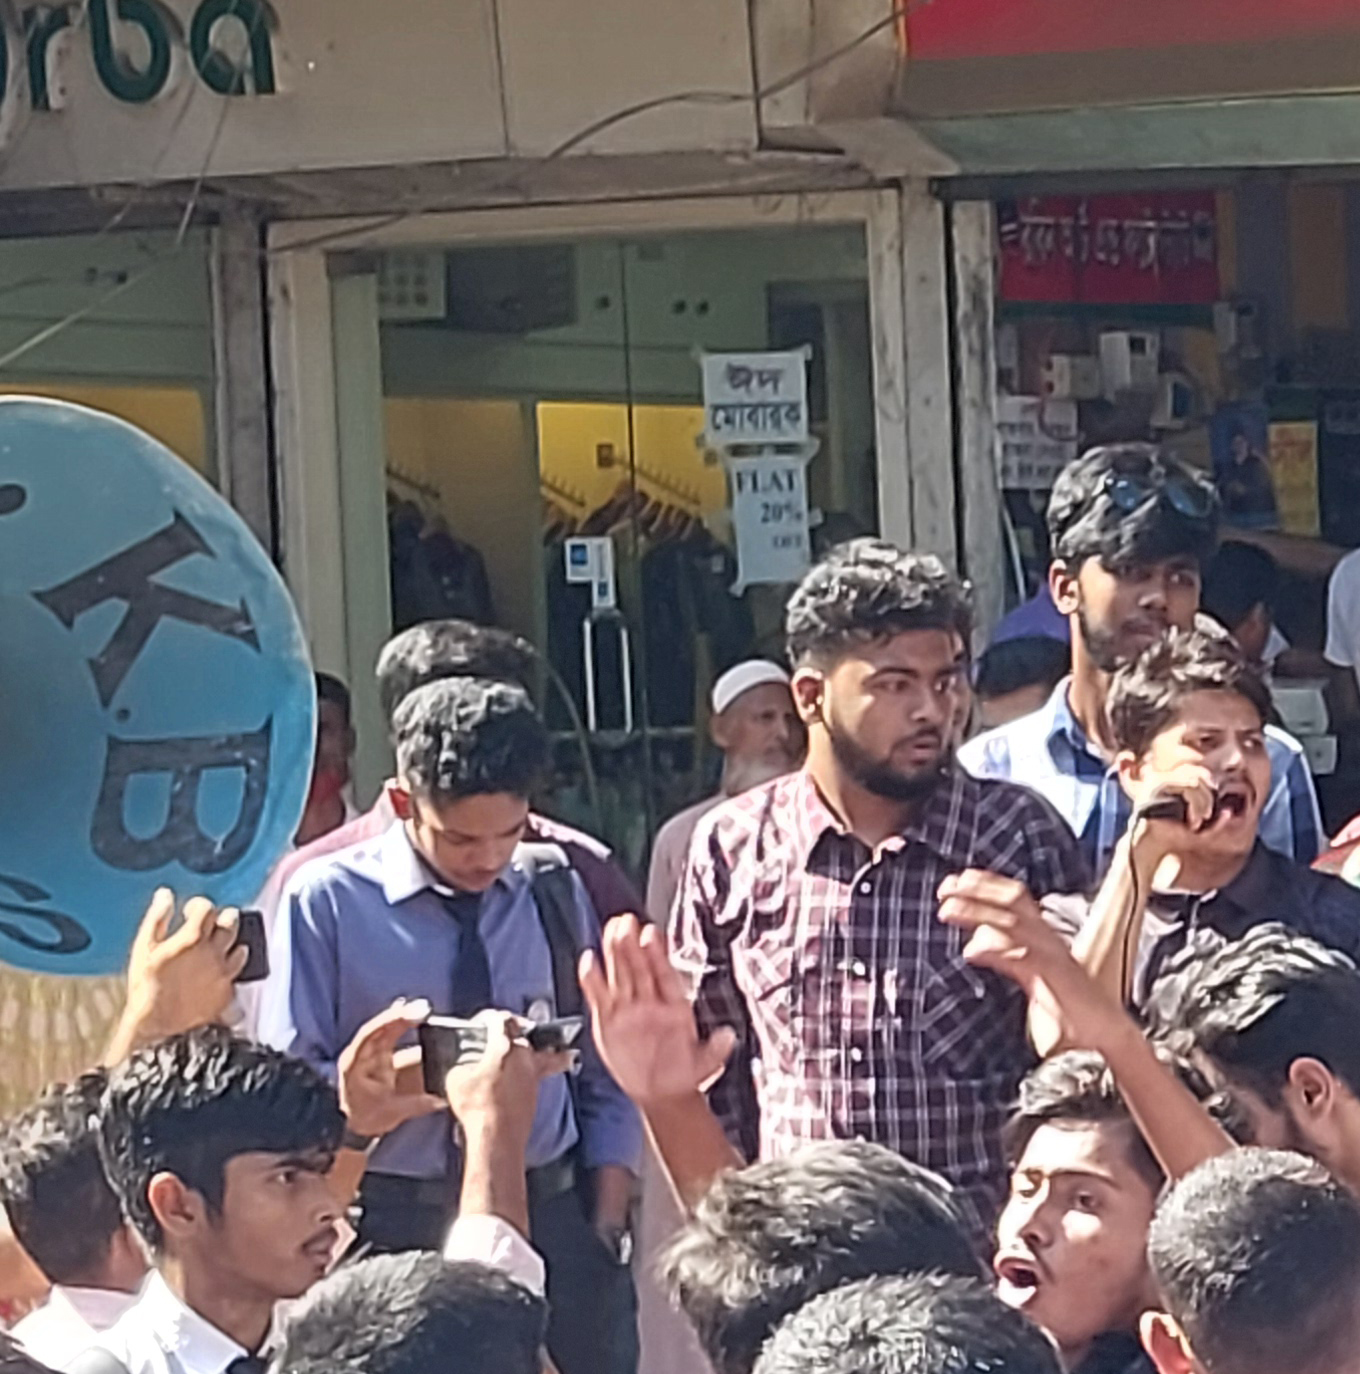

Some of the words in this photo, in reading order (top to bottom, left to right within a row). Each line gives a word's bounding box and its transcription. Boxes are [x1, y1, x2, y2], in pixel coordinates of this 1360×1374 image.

[0, 0, 276, 111] rba
[710, 402, 802, 432] মোবারক
[736, 469, 798, 494] FLAT
